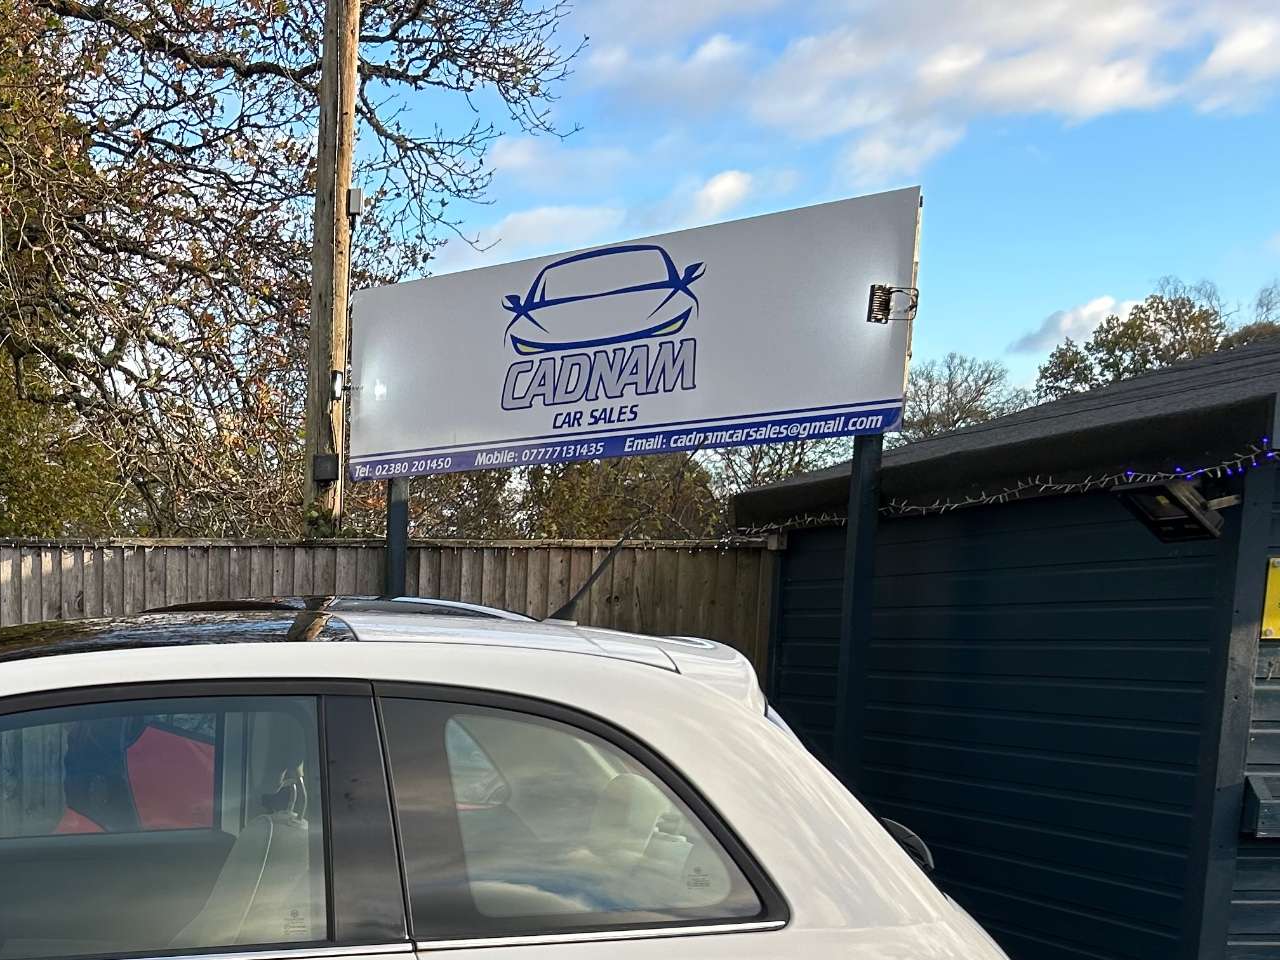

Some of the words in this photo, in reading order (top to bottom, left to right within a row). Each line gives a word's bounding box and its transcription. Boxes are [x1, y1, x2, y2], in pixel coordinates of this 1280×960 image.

[500, 337, 697, 411] CADNAM
[552, 410, 584, 430] CAR
[587, 404, 639, 426] SALES
[355, 464, 373, 477] Tel:
[375, 462, 408, 476] 02380
[411, 457, 452, 472] 201450
[474, 452, 518, 466] Mobile:
[521, 443, 605, 462] 07777131435
[623, 434, 667, 452] Email:
